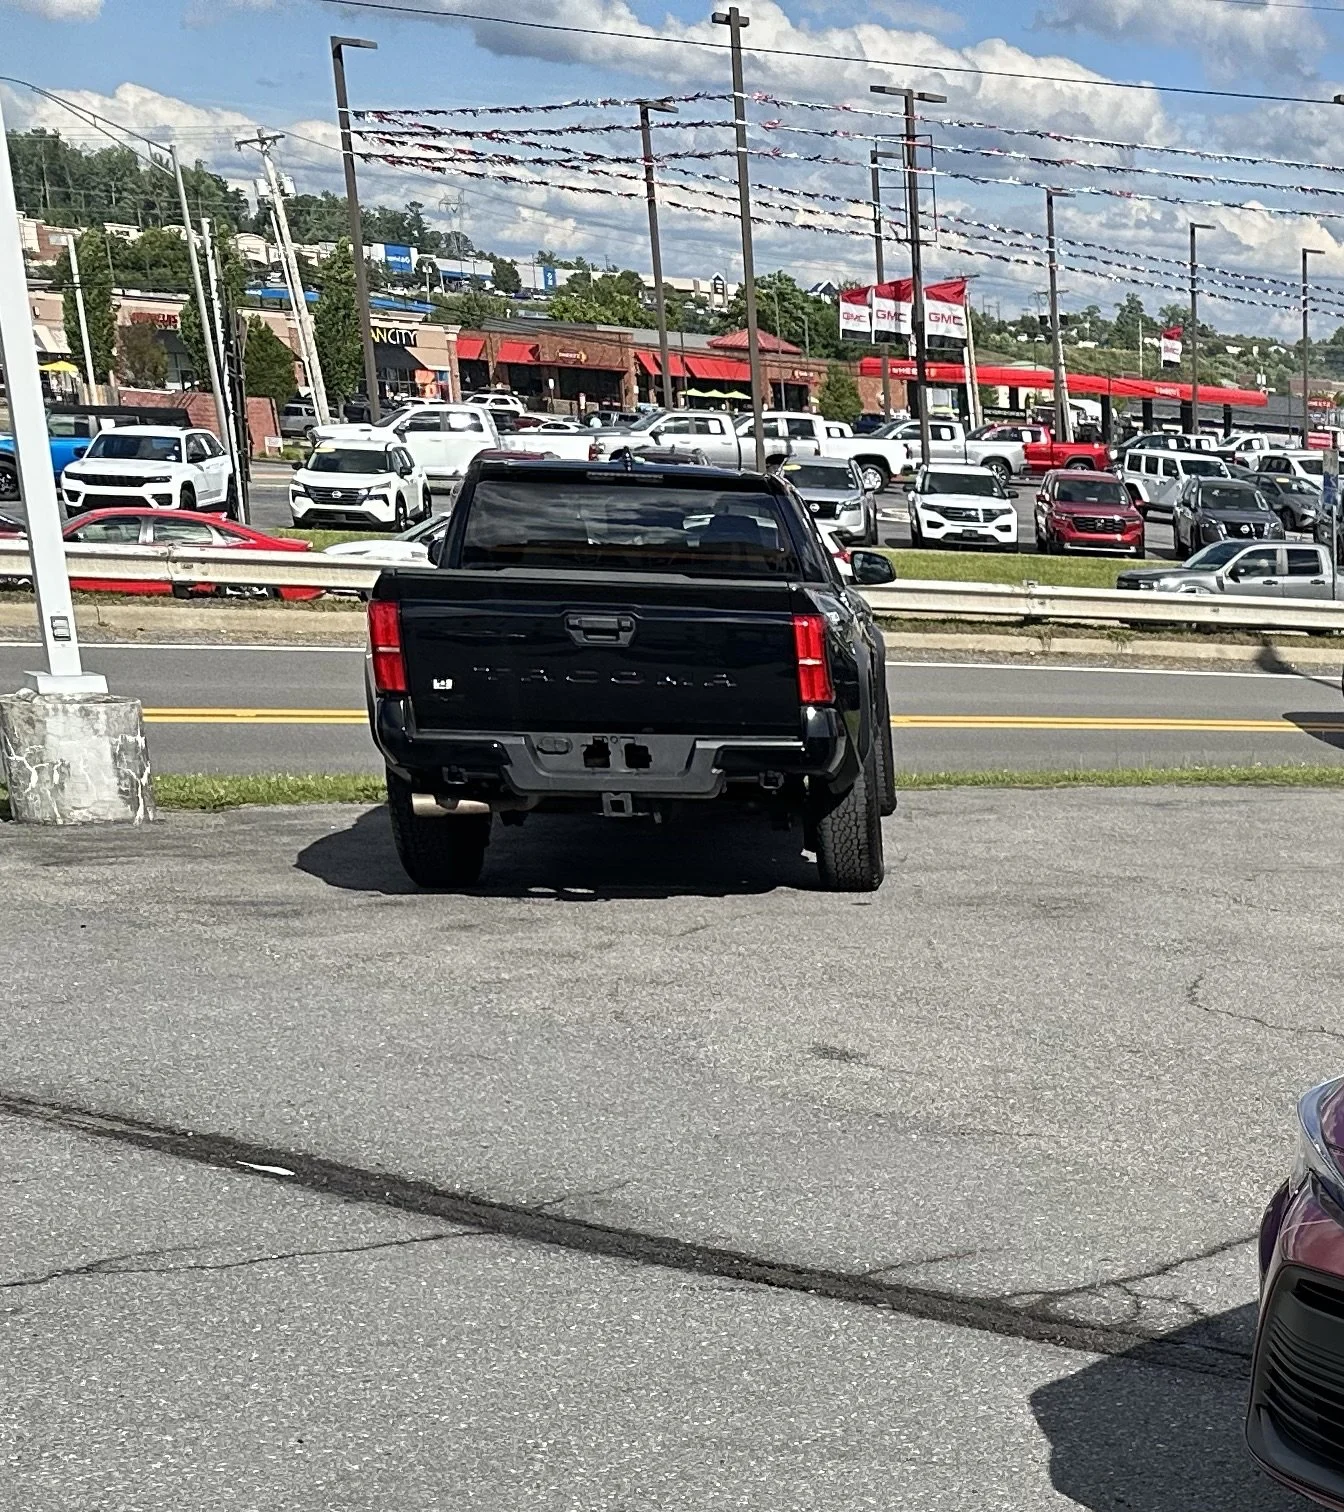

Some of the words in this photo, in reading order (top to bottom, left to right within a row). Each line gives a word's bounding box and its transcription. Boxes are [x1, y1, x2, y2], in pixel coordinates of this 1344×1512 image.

[876, 309, 907, 323] GMC
[928, 312, 964, 326] GMC
[388, 329, 417, 345] CITY
[472, 664, 739, 689] TACOMA
